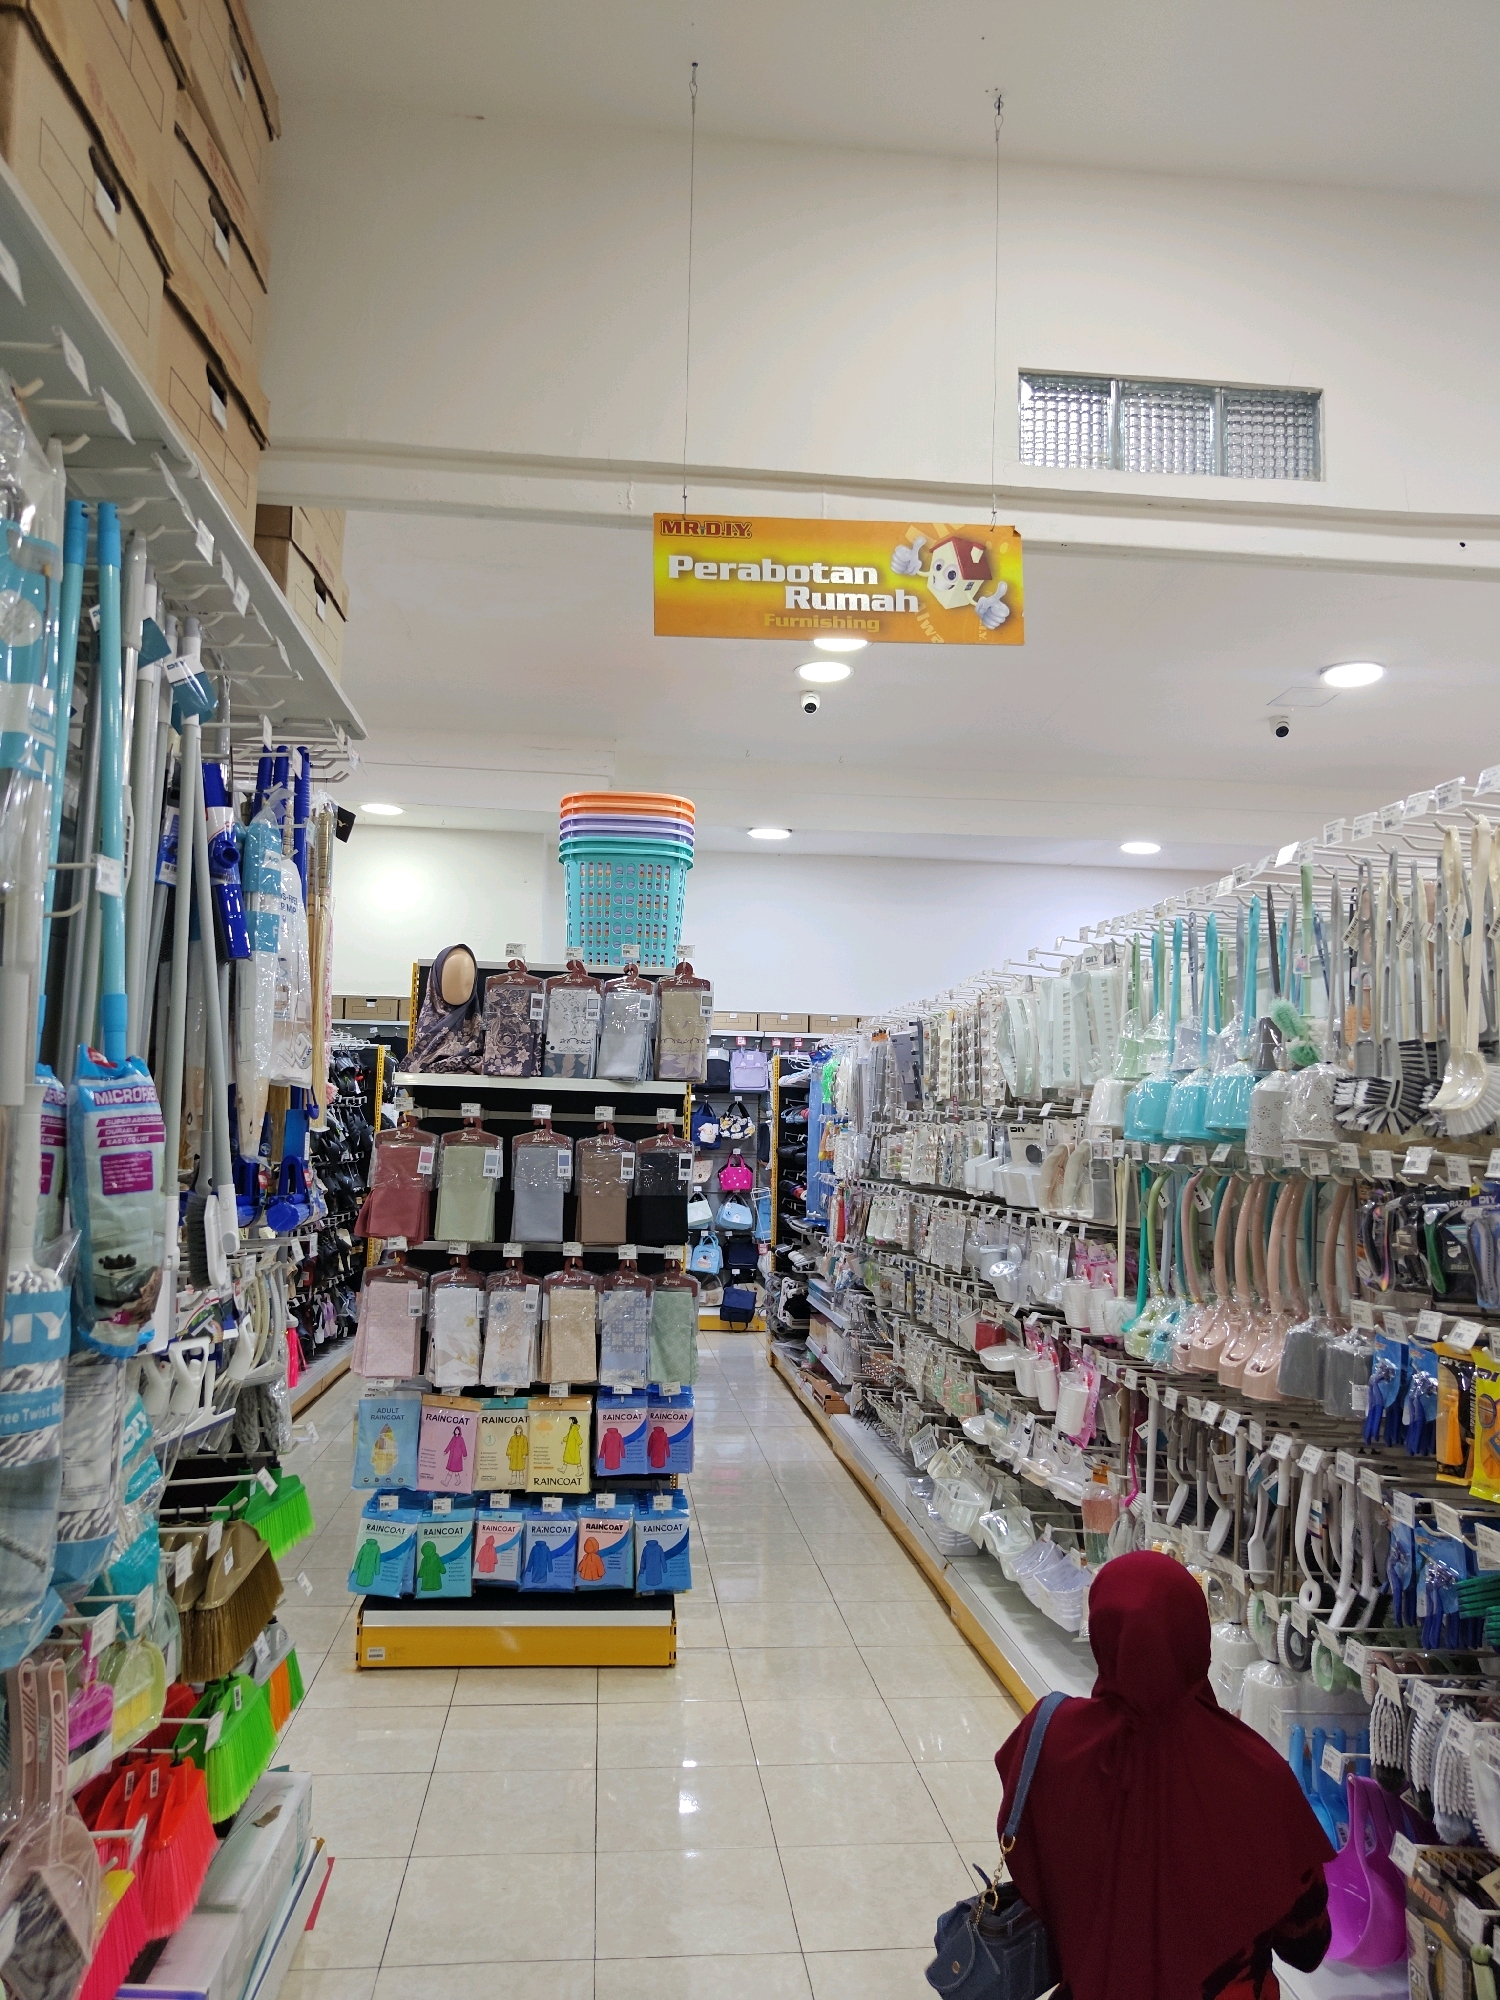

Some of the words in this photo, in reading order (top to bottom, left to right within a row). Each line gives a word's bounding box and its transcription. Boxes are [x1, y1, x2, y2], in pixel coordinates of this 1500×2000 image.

[668, 555, 878, 584] Perabotan
[785, 585, 919, 612] Rumah
[763, 613, 880, 632] Furnishing
[166, 659, 186, 671] DIY
[1086, 956, 1099, 964] DIY
[105, 1118, 131, 1126] SUPER
[105, 1126, 139, 1135] DURABLE
[137, 1135, 150, 1143] USE
[1479, 1195, 1497, 1204] DIY
[1476, 1367, 1500, 1382] DI
[0, 1413, 20, 1424] ree
[22, 1405, 50, 1422] Twist
[602, 1413, 643, 1421] RAINCOAT
[650, 1412, 688, 1421] RAINCOAT
[426, 1413, 471, 1426] RAINCOAT
[481, 1415, 529, 1424] RAINCOAT
[533, 1477, 583, 1486] RAINCOAT
[366, 1523, 406, 1535] RAINCOAT
[423, 1527, 464, 1536] RAINCOAT
[482, 1524, 516, 1532] RAINCOAT
[531, 1525, 572, 1534] RAINCOAT
[585, 1523, 623, 1531] RAINCOAT
[643, 1523, 683, 1532] RAINCOAT
